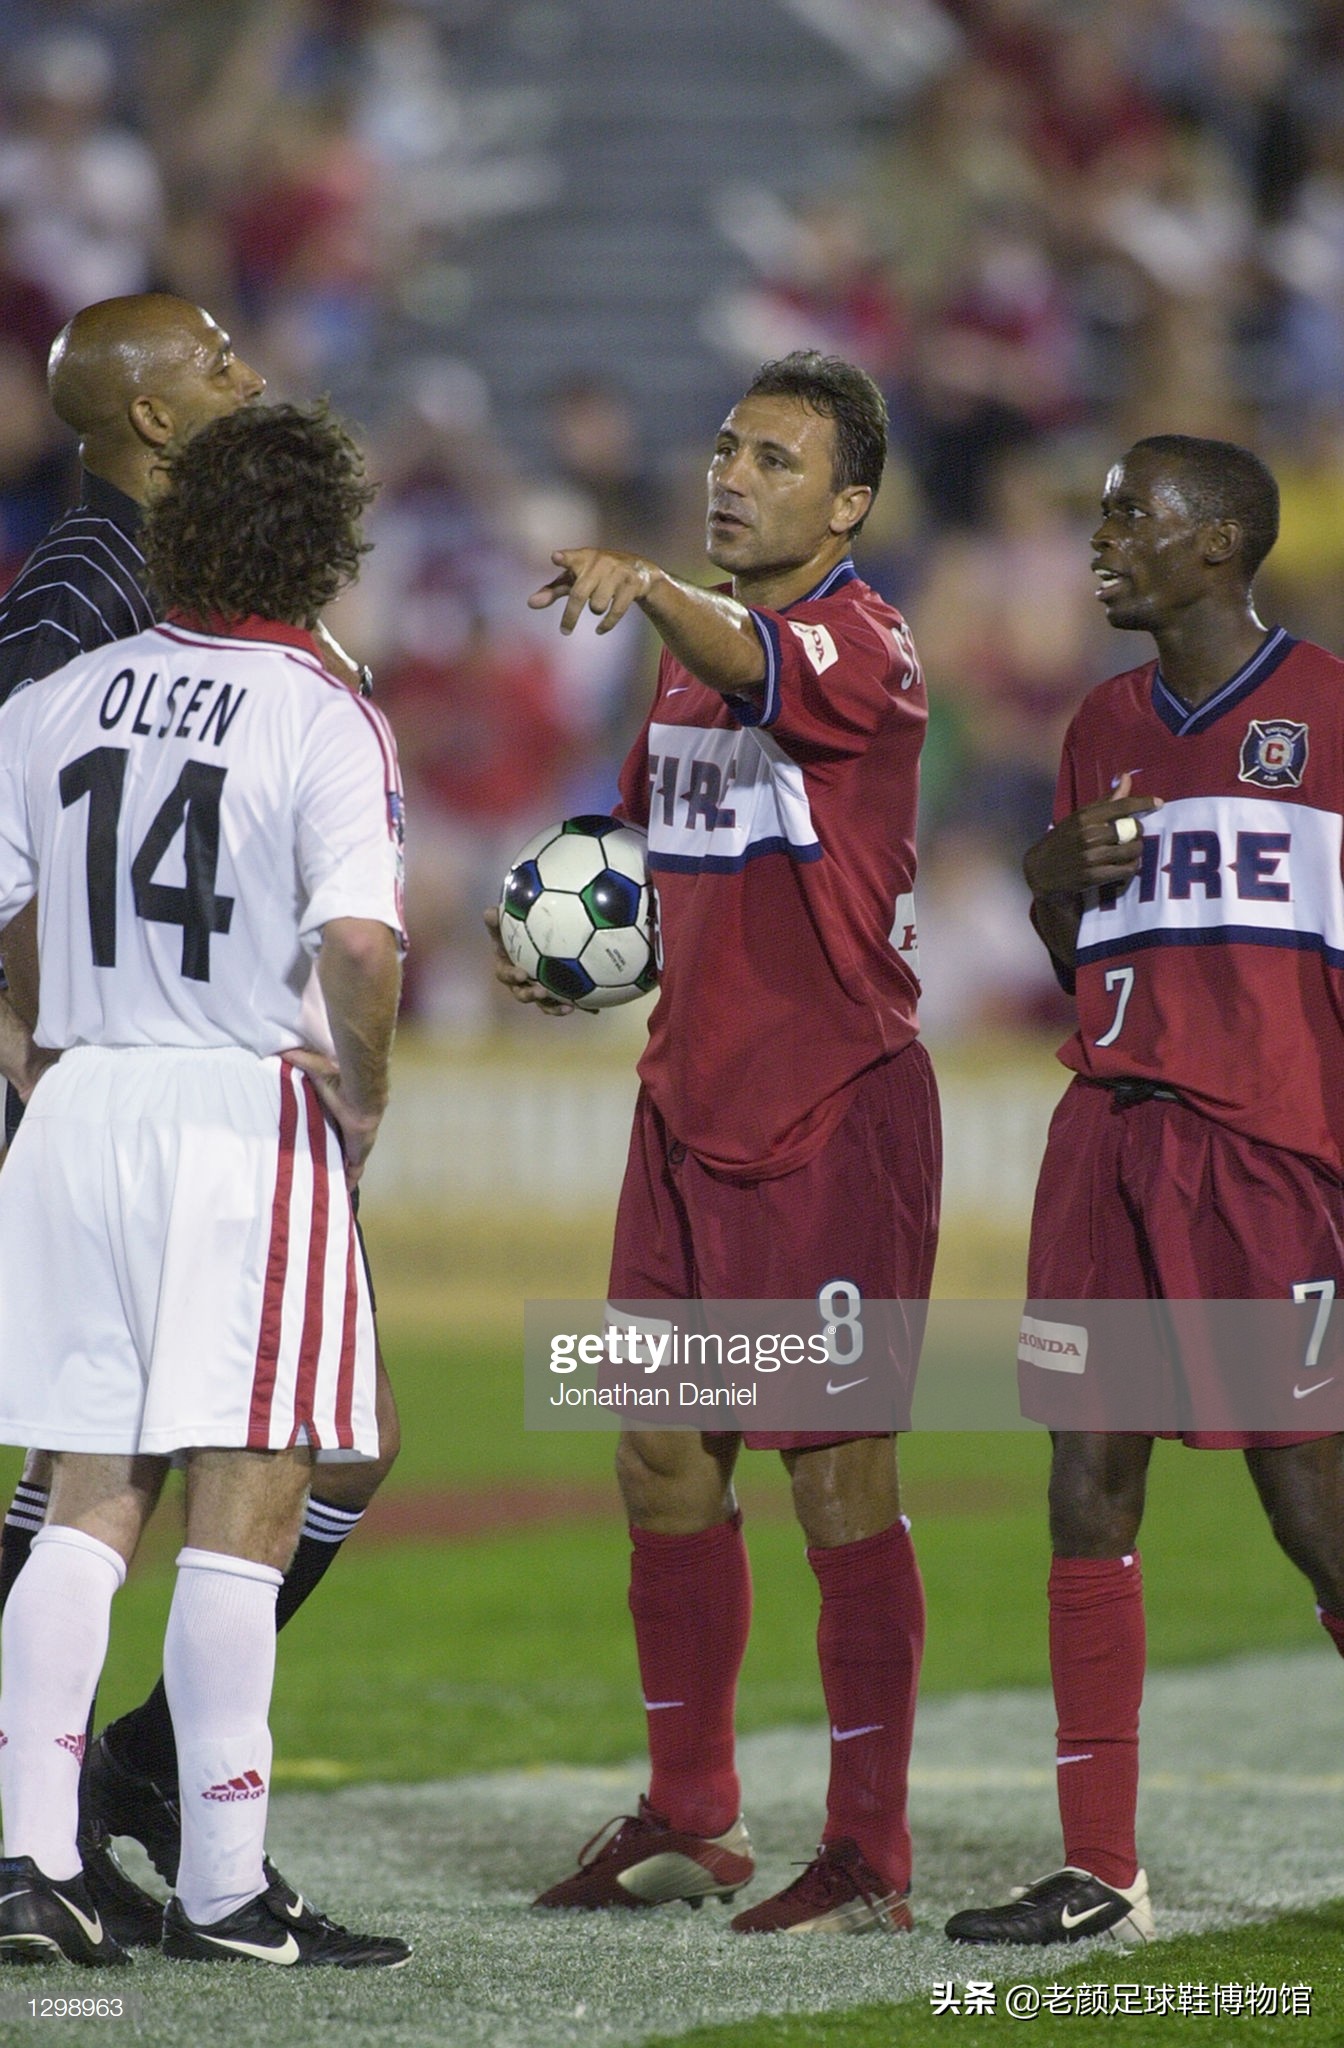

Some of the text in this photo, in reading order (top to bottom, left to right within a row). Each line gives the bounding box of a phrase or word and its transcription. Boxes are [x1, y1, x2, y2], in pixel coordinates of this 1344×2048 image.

[99, 668, 248, 748] OLSEN
[1265, 742, 1285, 766] C
[58, 745, 236, 983] 14
[1099, 830, 1292, 912] IRE
[1095, 965, 1135, 1048] 7
[816, 1277, 864, 1366] 8
[1018, 1331, 1081, 1357] HONDA
[1291, 1278, 1336, 1367] 7
[201, 1786, 265, 1802] adidas
